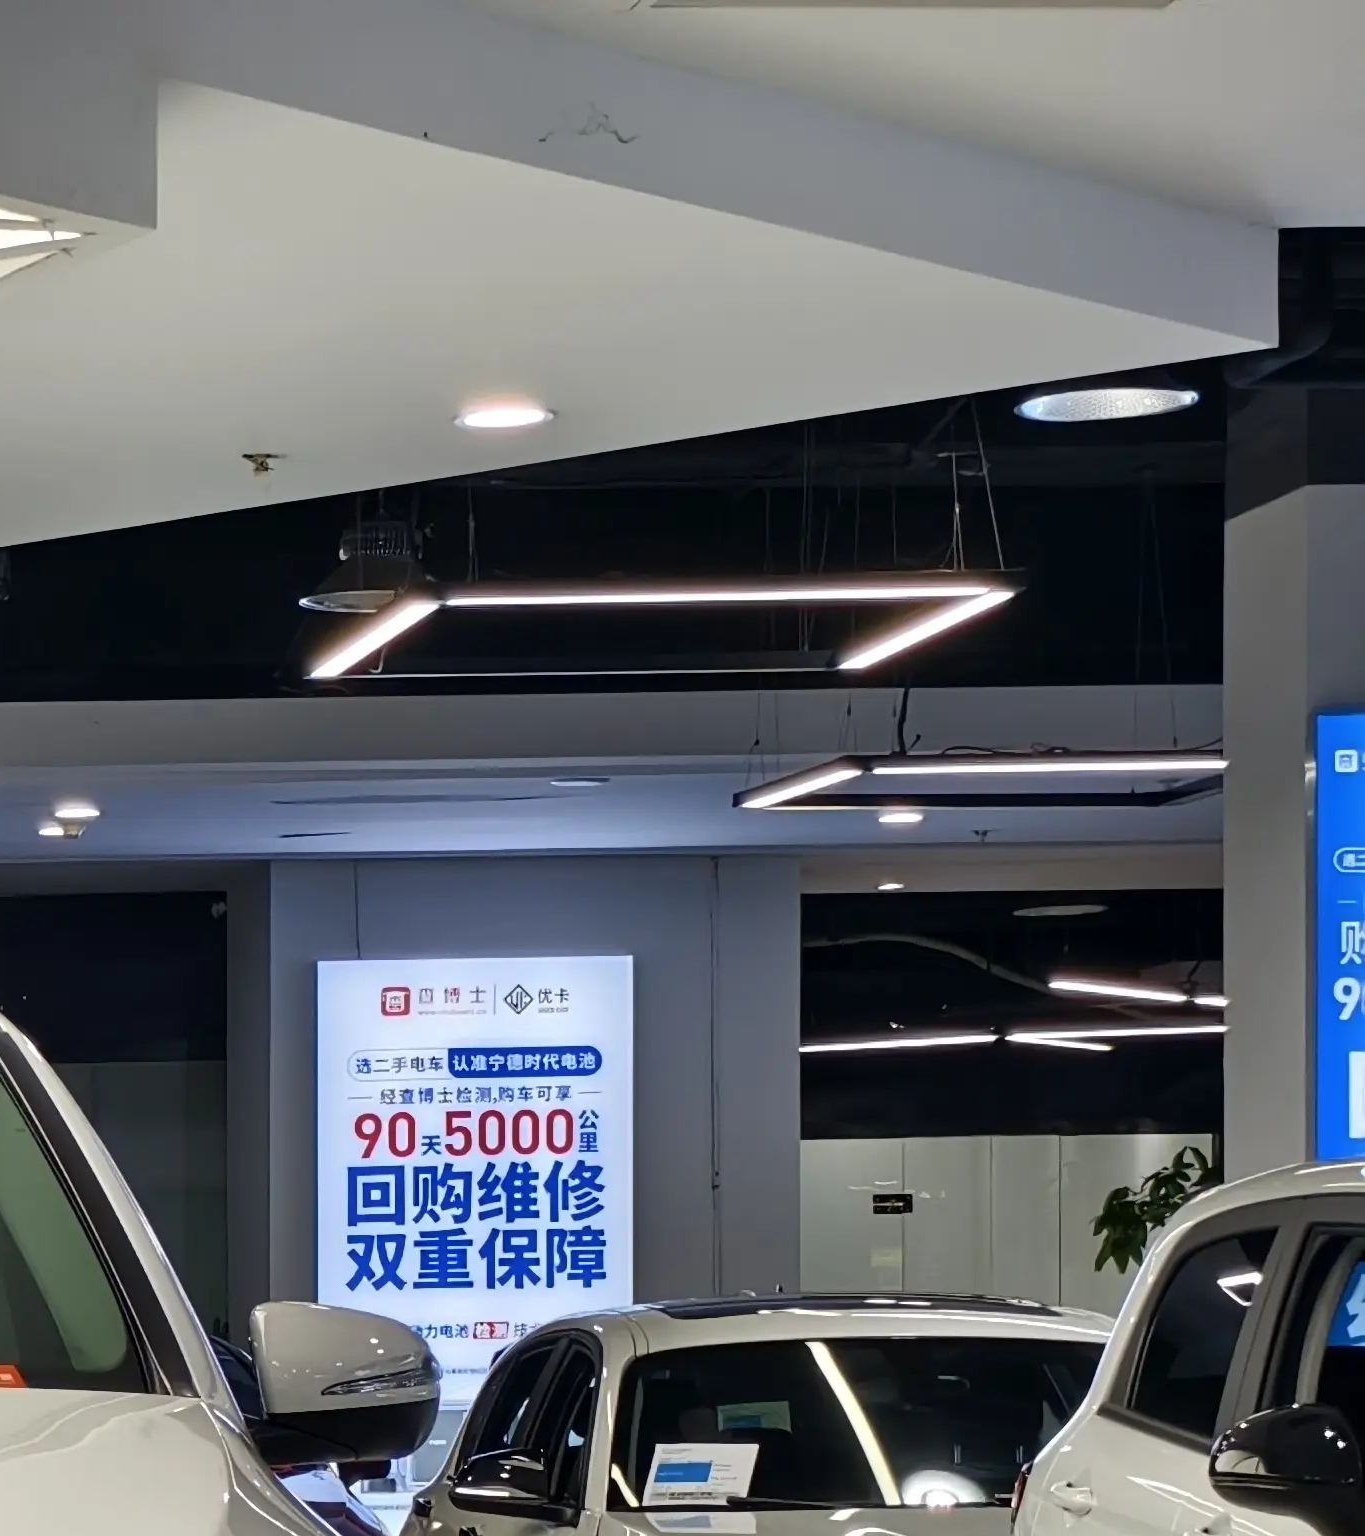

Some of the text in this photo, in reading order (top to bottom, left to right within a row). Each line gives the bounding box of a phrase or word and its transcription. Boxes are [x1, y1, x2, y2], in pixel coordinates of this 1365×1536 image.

[537, 986, 570, 1004] 优卡
[355, 1051, 596, 1075] 选二手电车 认准宁德时代电池
[346, 1160, 606, 1227] 回购维修
[345, 1225, 607, 1292] 双重保障
